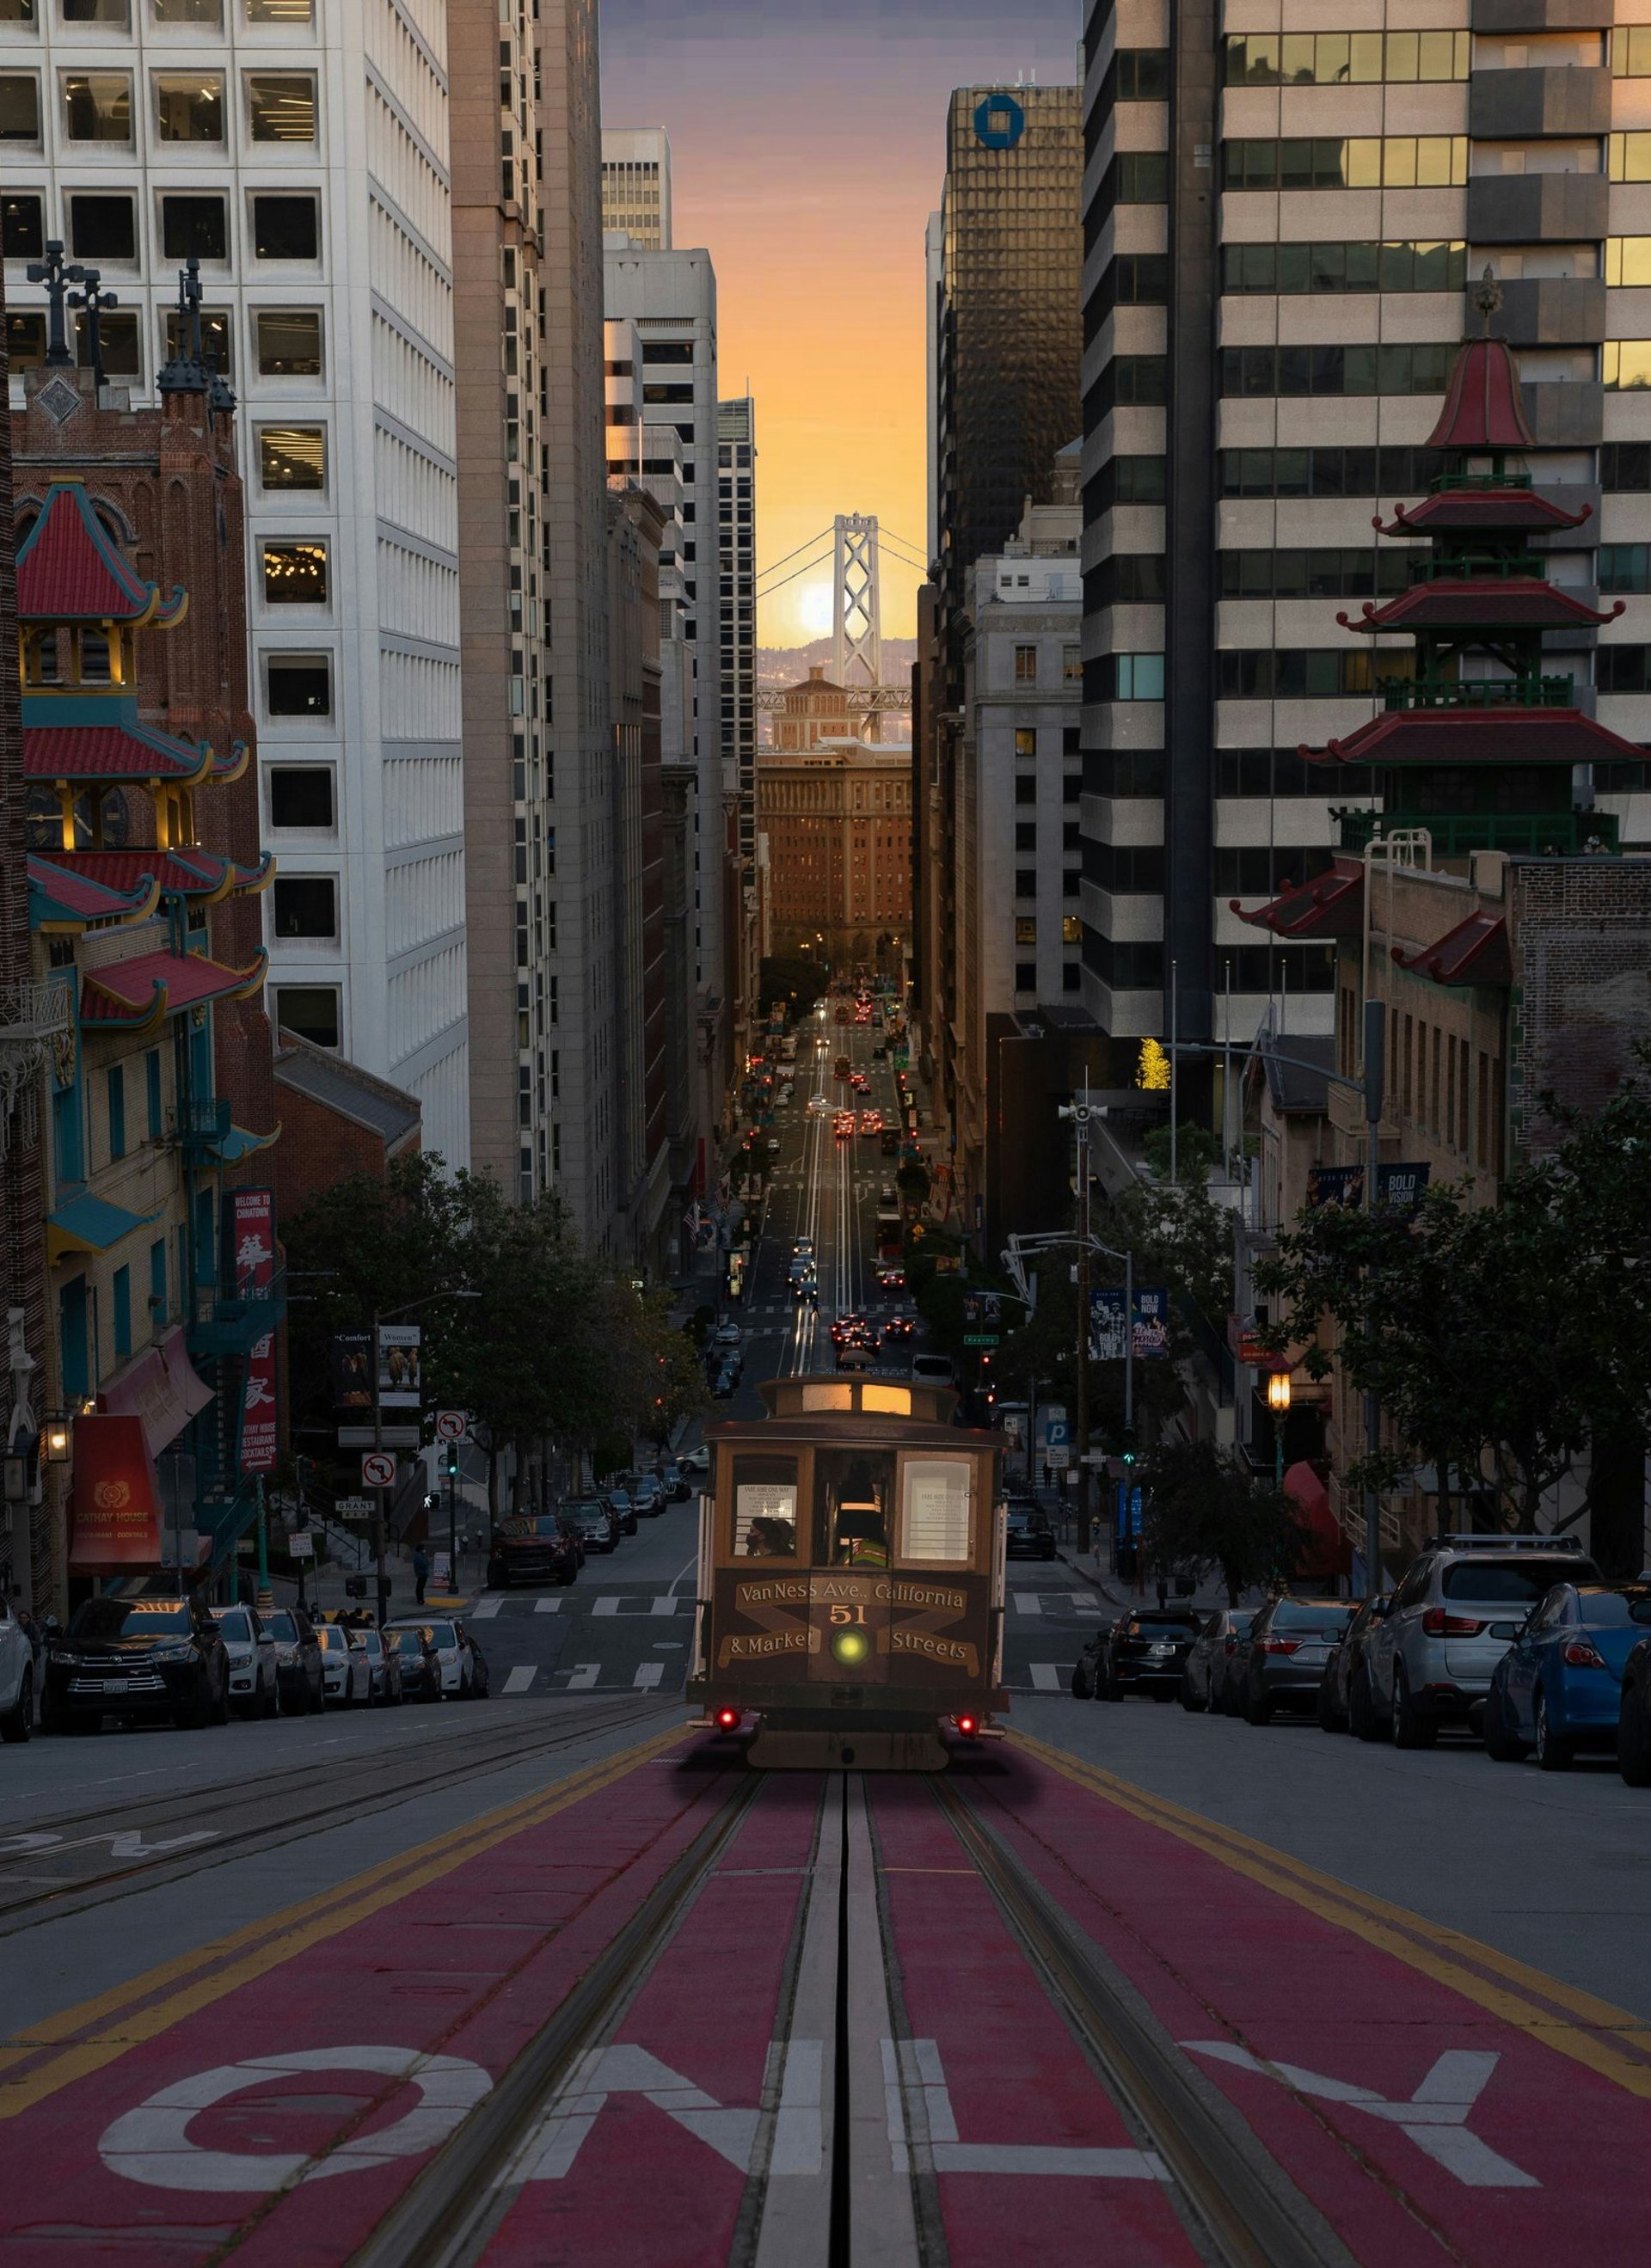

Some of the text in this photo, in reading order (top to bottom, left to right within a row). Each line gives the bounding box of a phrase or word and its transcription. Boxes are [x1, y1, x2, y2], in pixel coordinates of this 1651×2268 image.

[1389, 1174, 1415, 1191] BOLD
[235, 1194, 271, 1206] WELCOME TO
[1389, 1191, 1414, 1204] VISION
[236, 1206, 269, 1219] CHINATOWN
[1140, 1295, 1159, 1304] BOLD
[1140, 1303, 1159, 1314] NOW
[242, 1422, 276, 1434] ATHAY HOUSE
[242, 1433, 276, 1447] ESTAURANT
[241, 1447, 270, 1459] COCKTAILS
[76, 1512, 149, 1523] CATHAY HOUSE
[741, 1585, 771, 1603] Van
[774, 1583, 818, 1599] Ness
[875, 1584, 964, 1609] California
[830, 1604, 868, 1624] 51
[730, 1632, 967, 1659] & Market Streets
[96, 2038, 1544, 2192] ONLY
